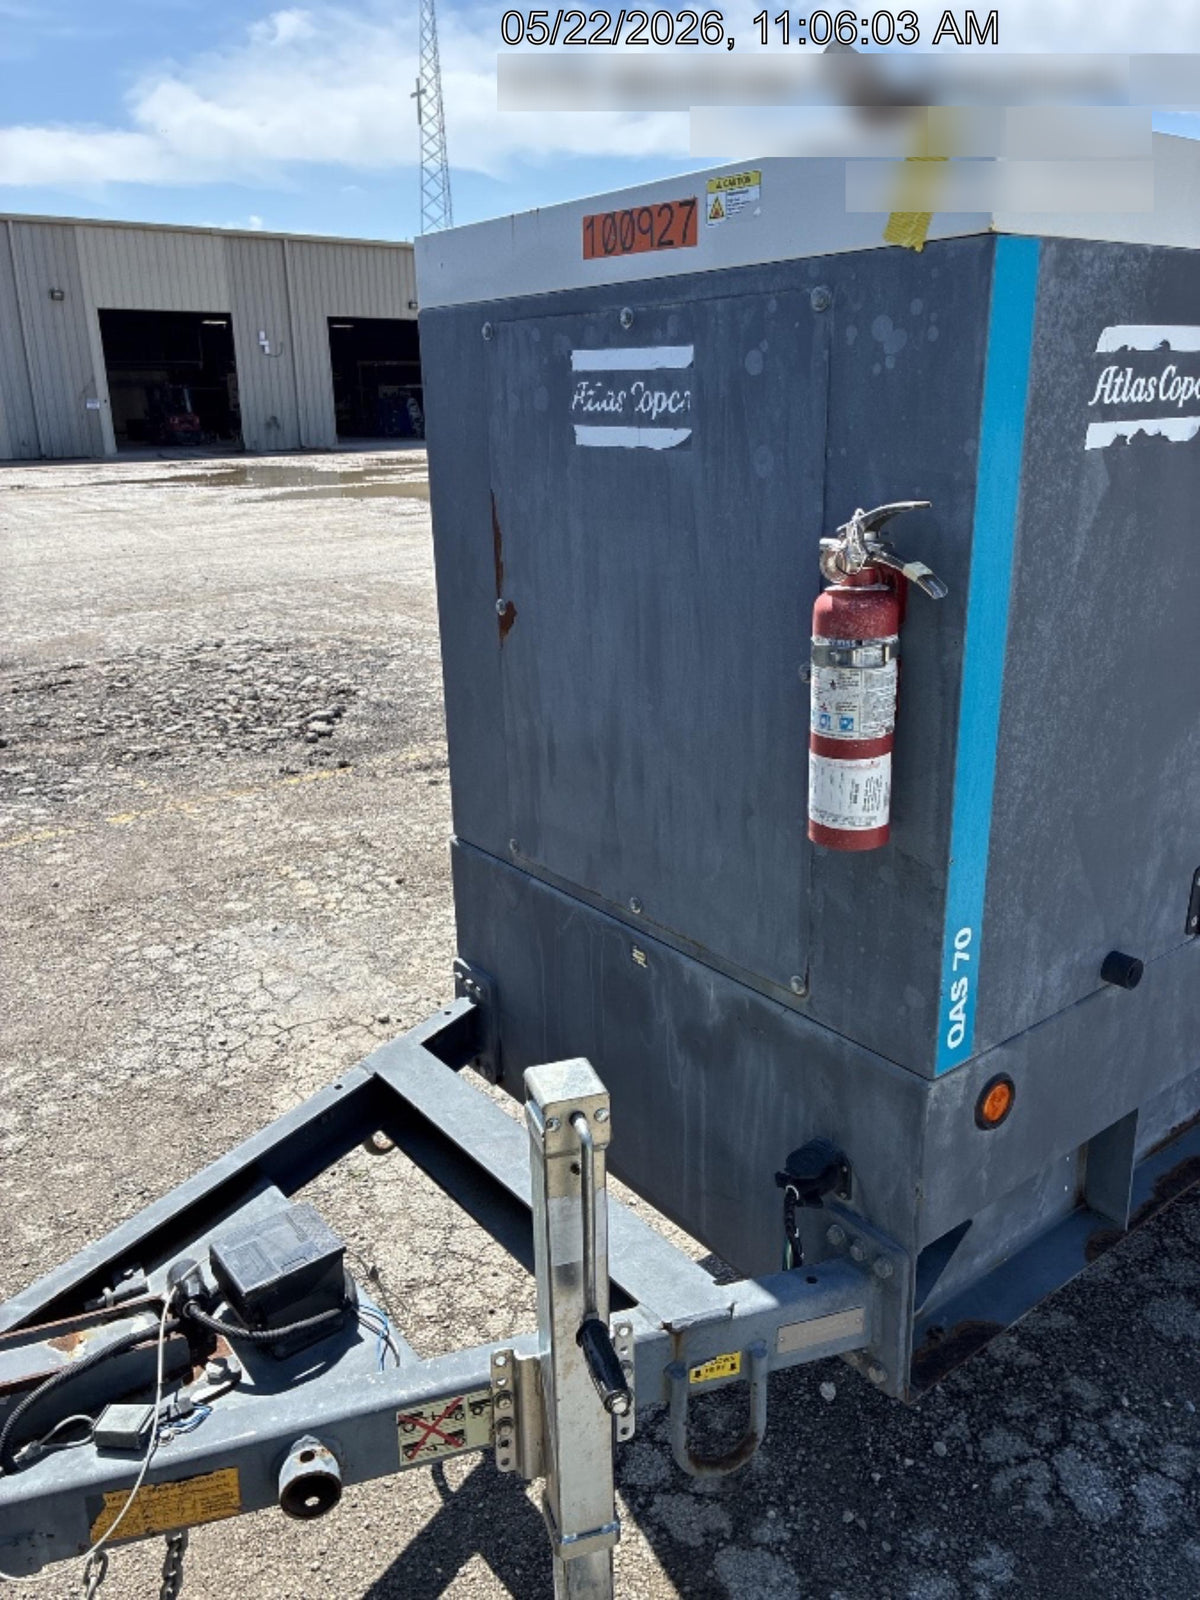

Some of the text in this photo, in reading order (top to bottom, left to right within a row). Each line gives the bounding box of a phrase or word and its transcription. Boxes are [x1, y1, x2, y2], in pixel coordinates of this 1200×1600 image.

[722, 175, 752, 188] CAUTION
[586, 197, 697, 256] 100927
[1088, 365, 1157, 406] Atlas
[952, 927, 972, 971] 70
